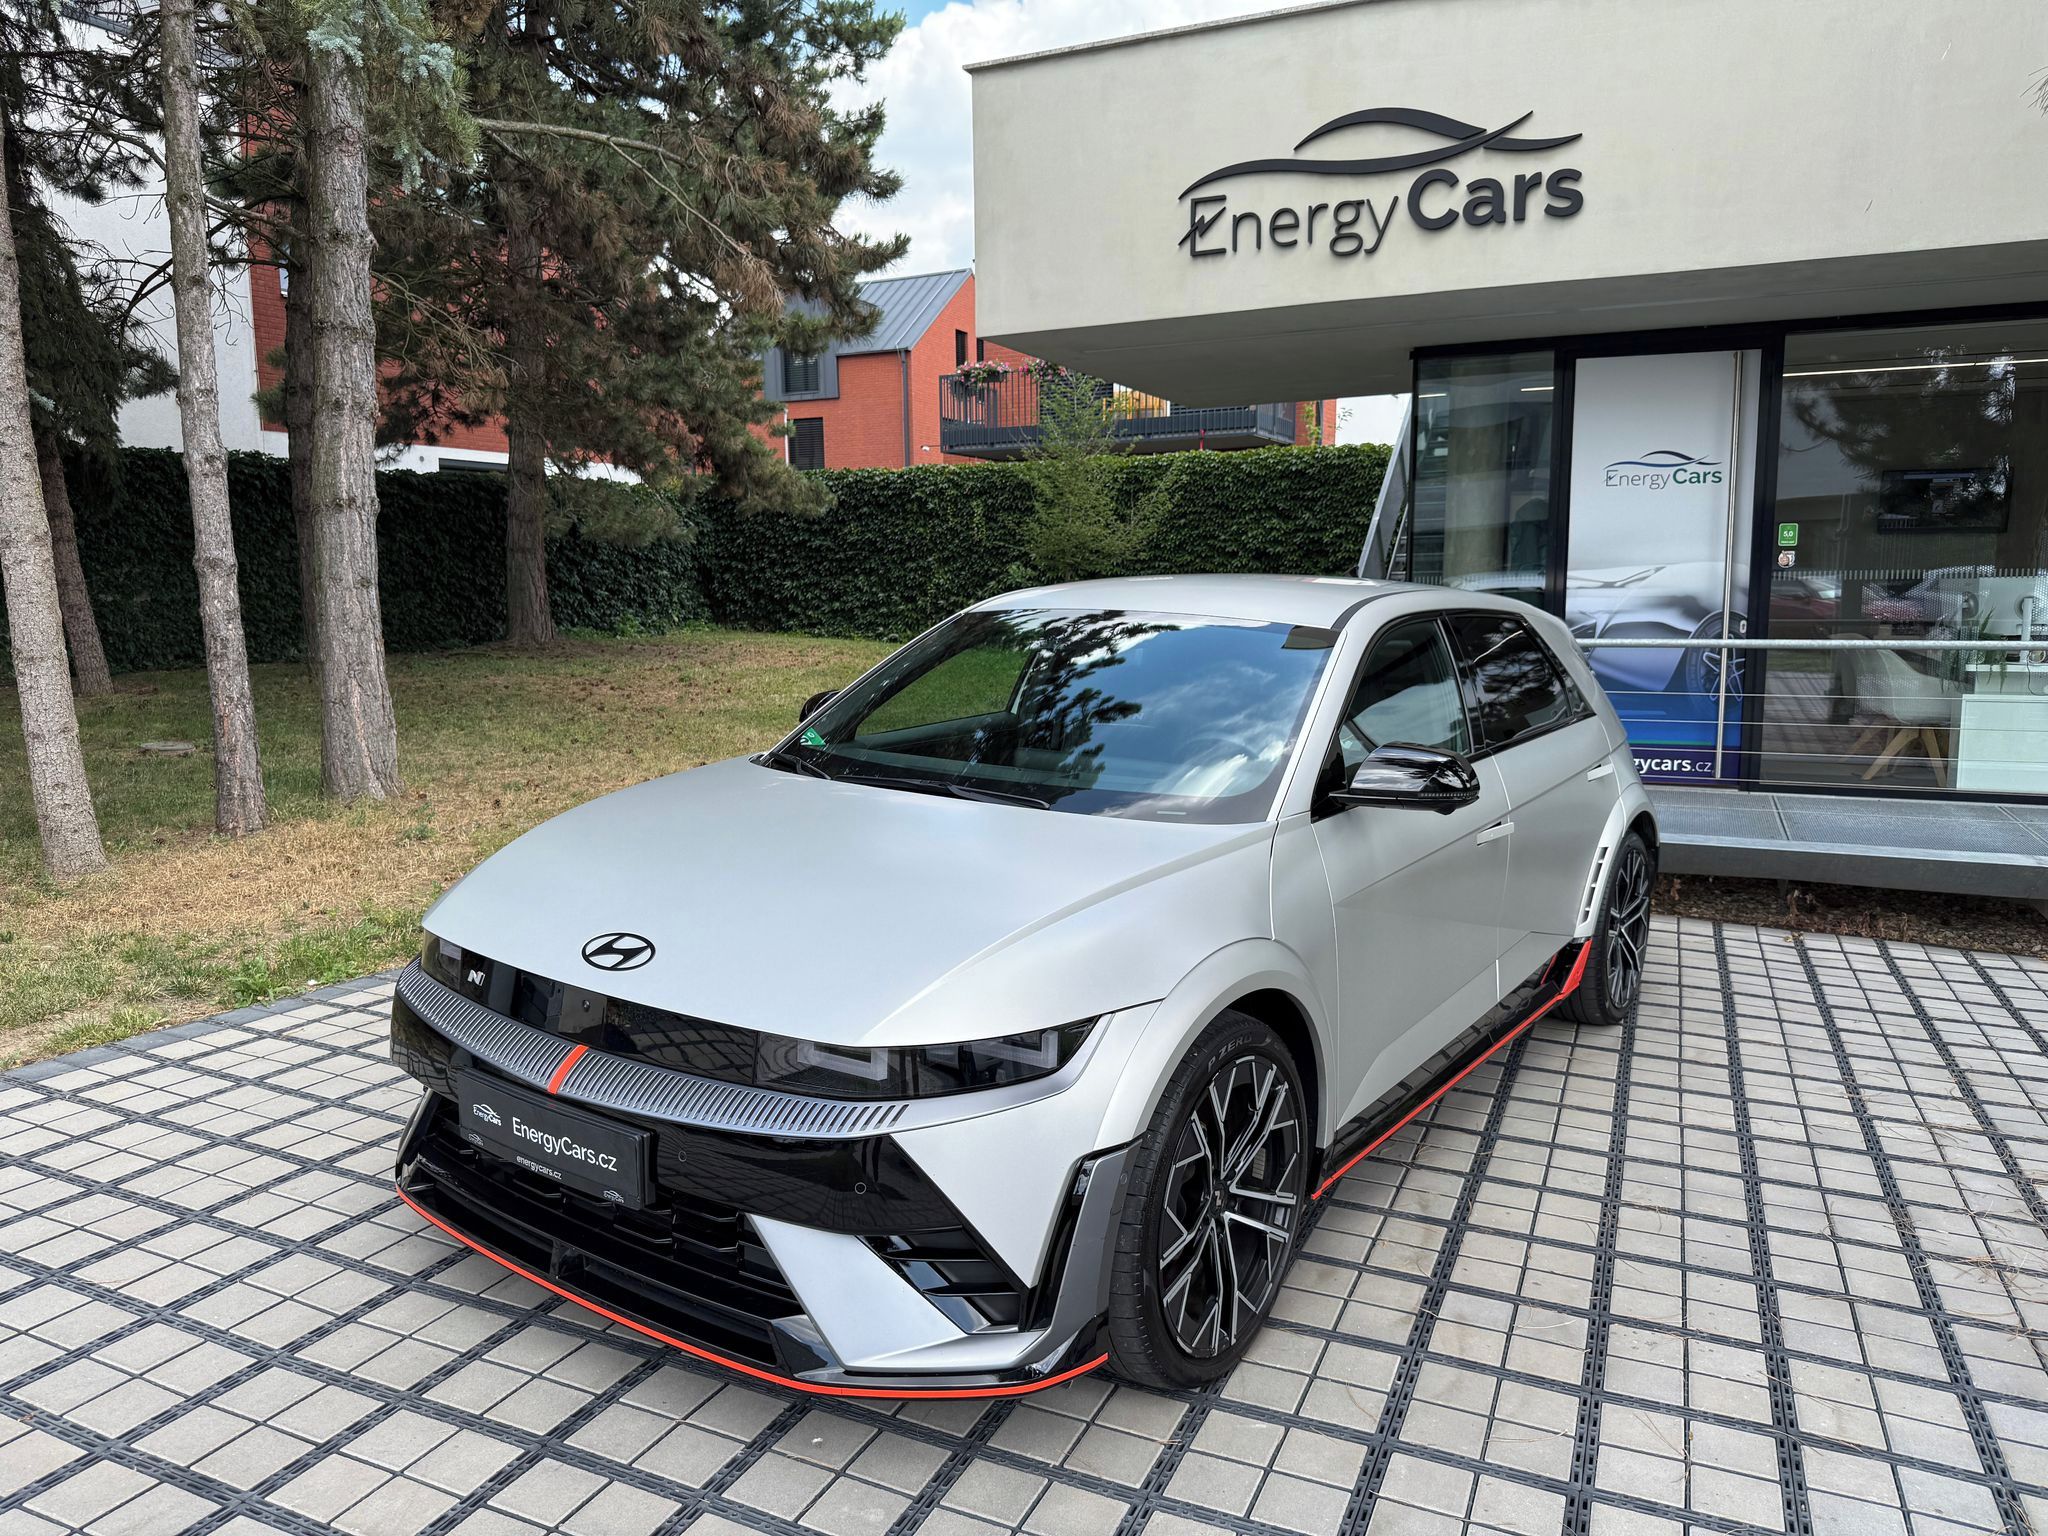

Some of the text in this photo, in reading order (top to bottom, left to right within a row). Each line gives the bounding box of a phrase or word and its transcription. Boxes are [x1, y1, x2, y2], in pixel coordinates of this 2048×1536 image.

[1178, 167, 1584, 258] EnergyCars
[1604, 467, 1723, 490] EnergyCars
[512, 1116, 618, 1172] EnergyCars.cz
[516, 1154, 562, 1180] energycars.cz
